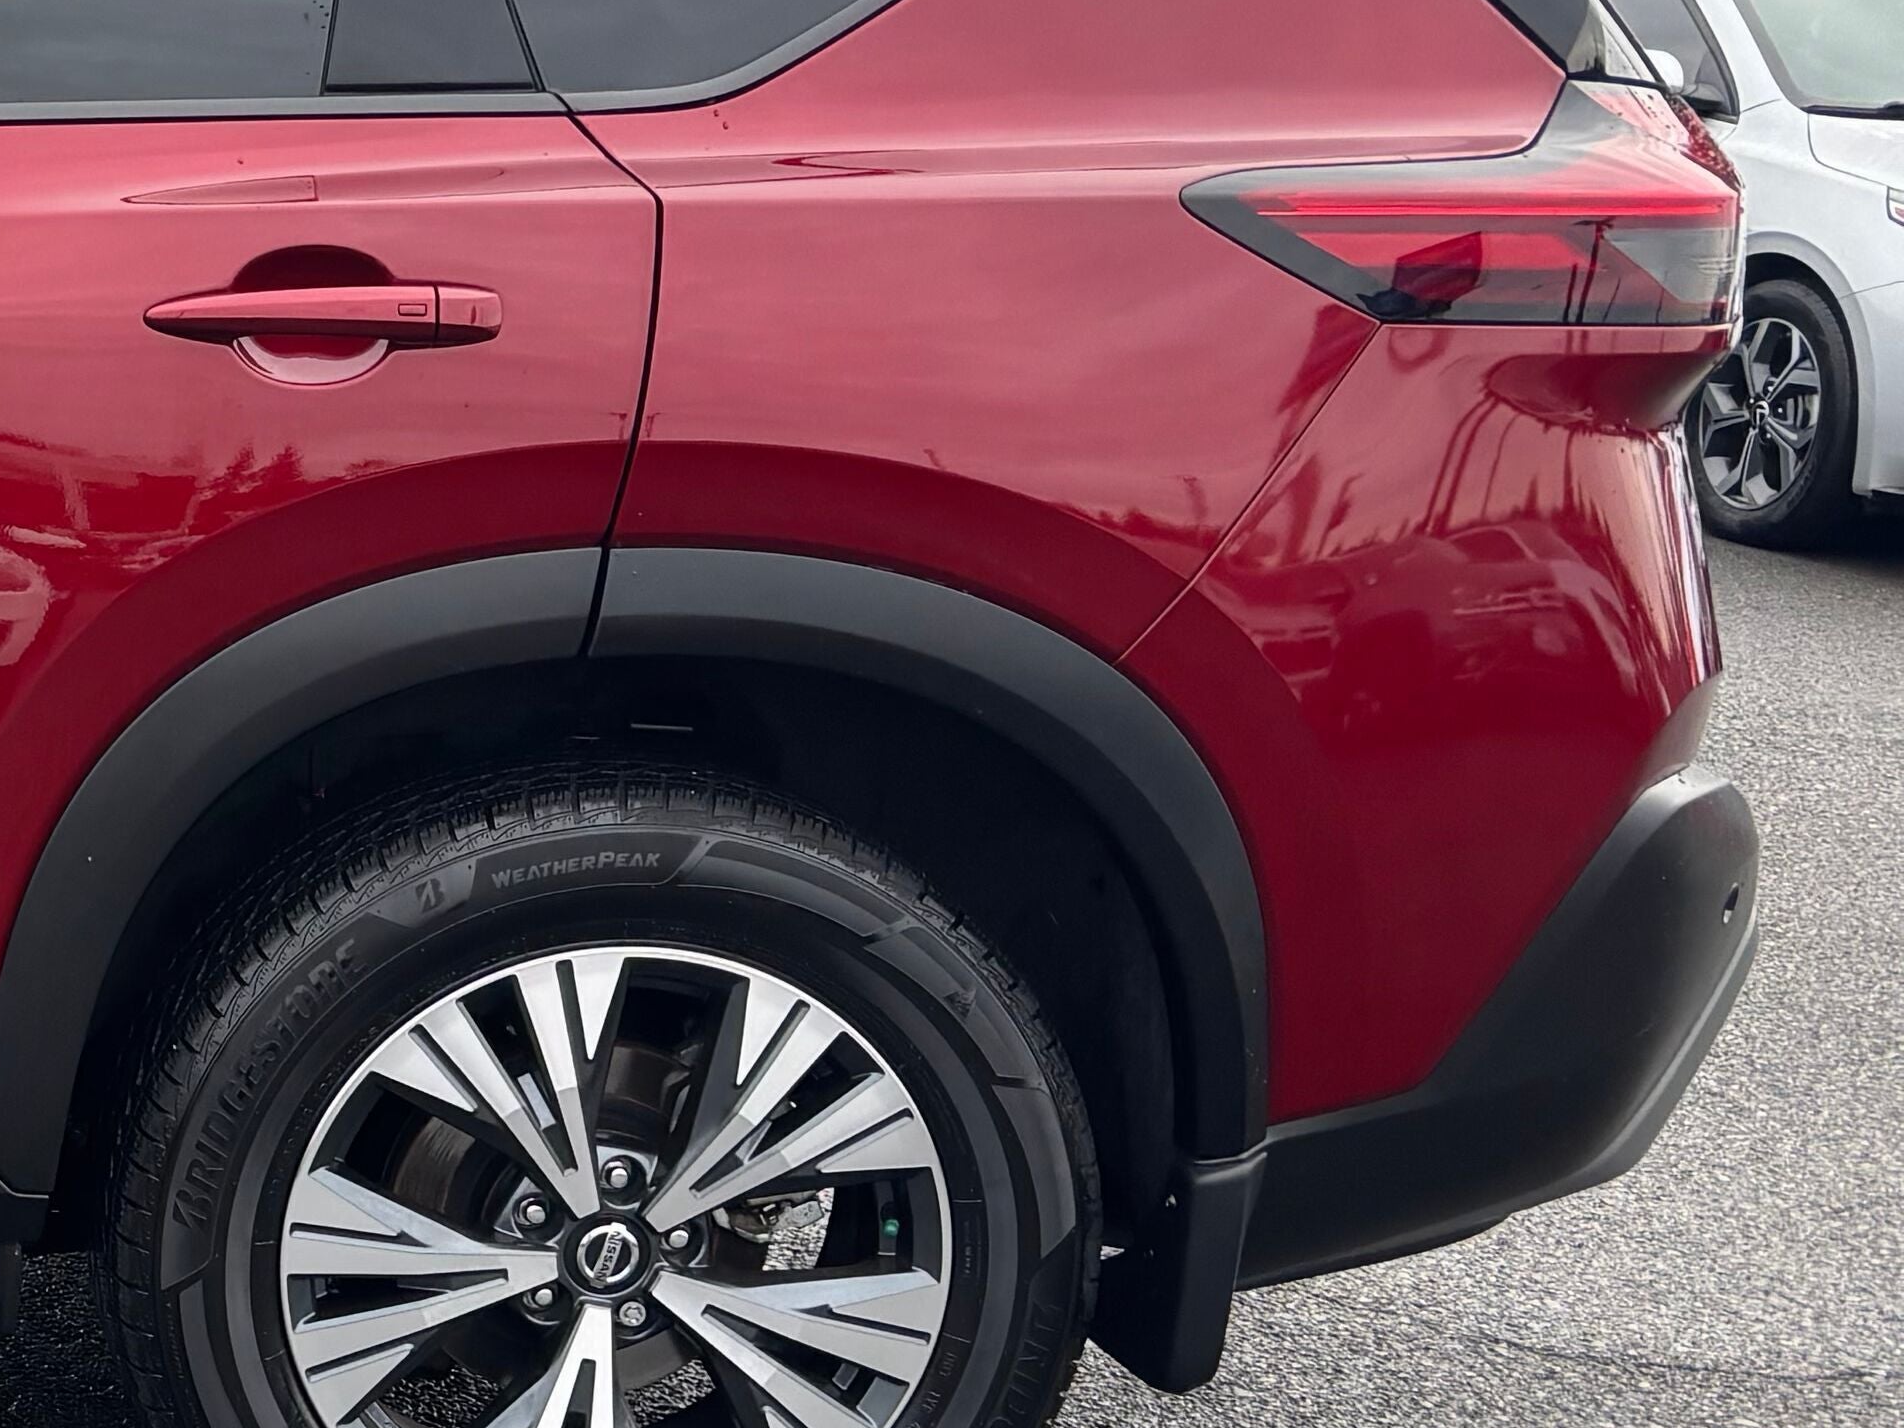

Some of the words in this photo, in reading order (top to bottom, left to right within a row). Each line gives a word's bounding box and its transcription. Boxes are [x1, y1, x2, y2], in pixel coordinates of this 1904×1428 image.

[492, 850, 661, 890] WEATHERPEAK
[172, 938, 369, 1230] BRIDGESTONE
[596, 1230, 624, 1282] NISSAN
